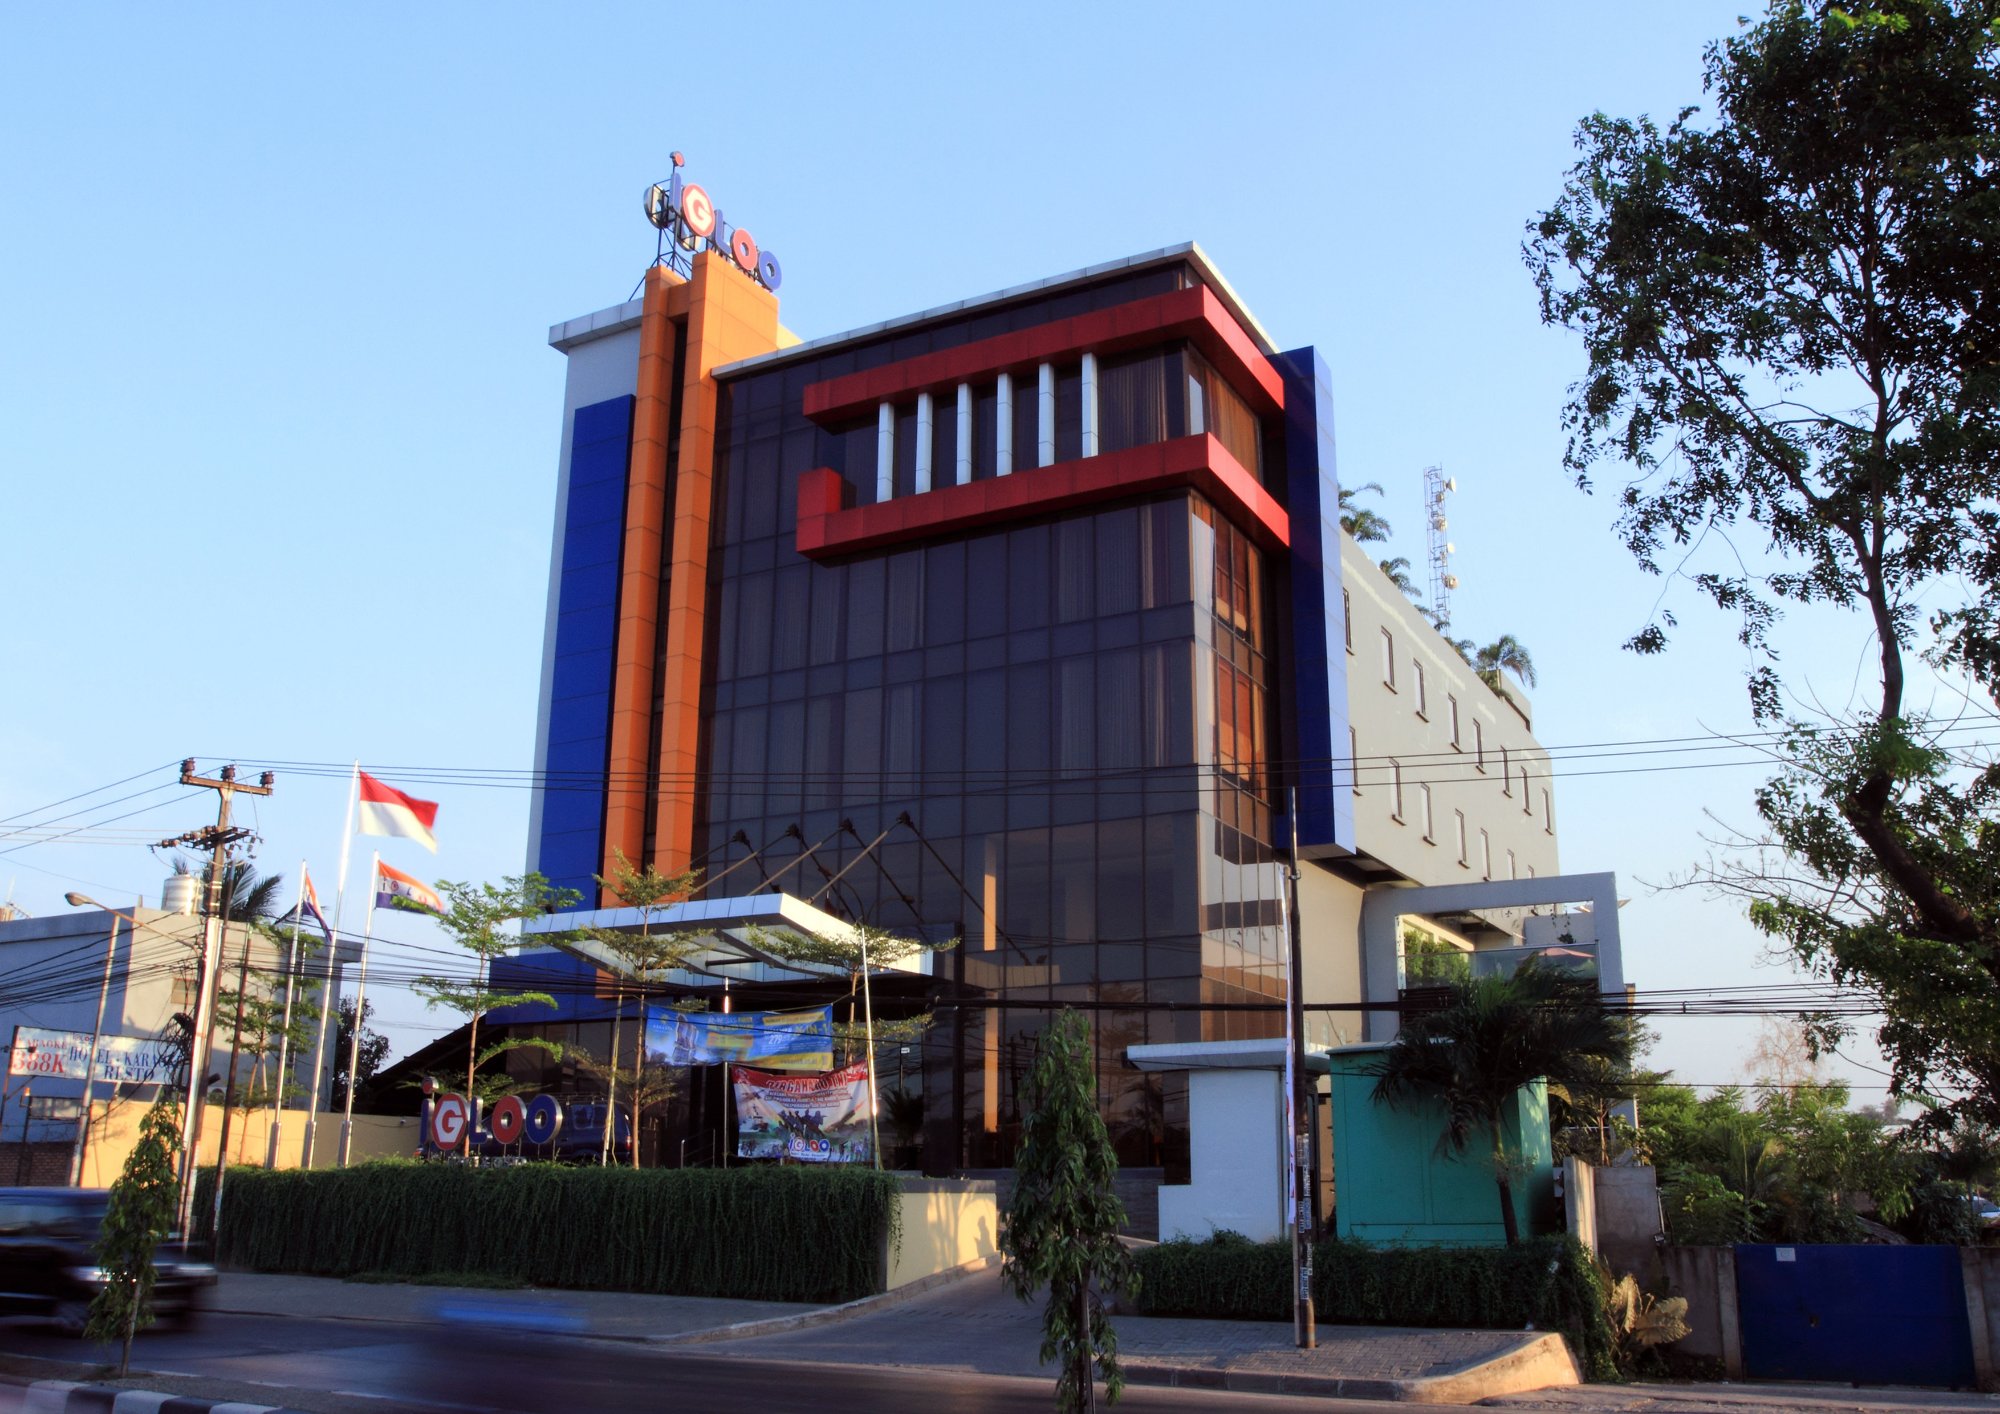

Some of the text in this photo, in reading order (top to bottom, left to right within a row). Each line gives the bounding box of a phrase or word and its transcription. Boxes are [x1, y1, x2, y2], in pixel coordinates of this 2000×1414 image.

[13, 1051, 65, 1074] 388K
[69, 1046, 112, 1065] HOEL
[104, 1065, 155, 1082] RESTO
